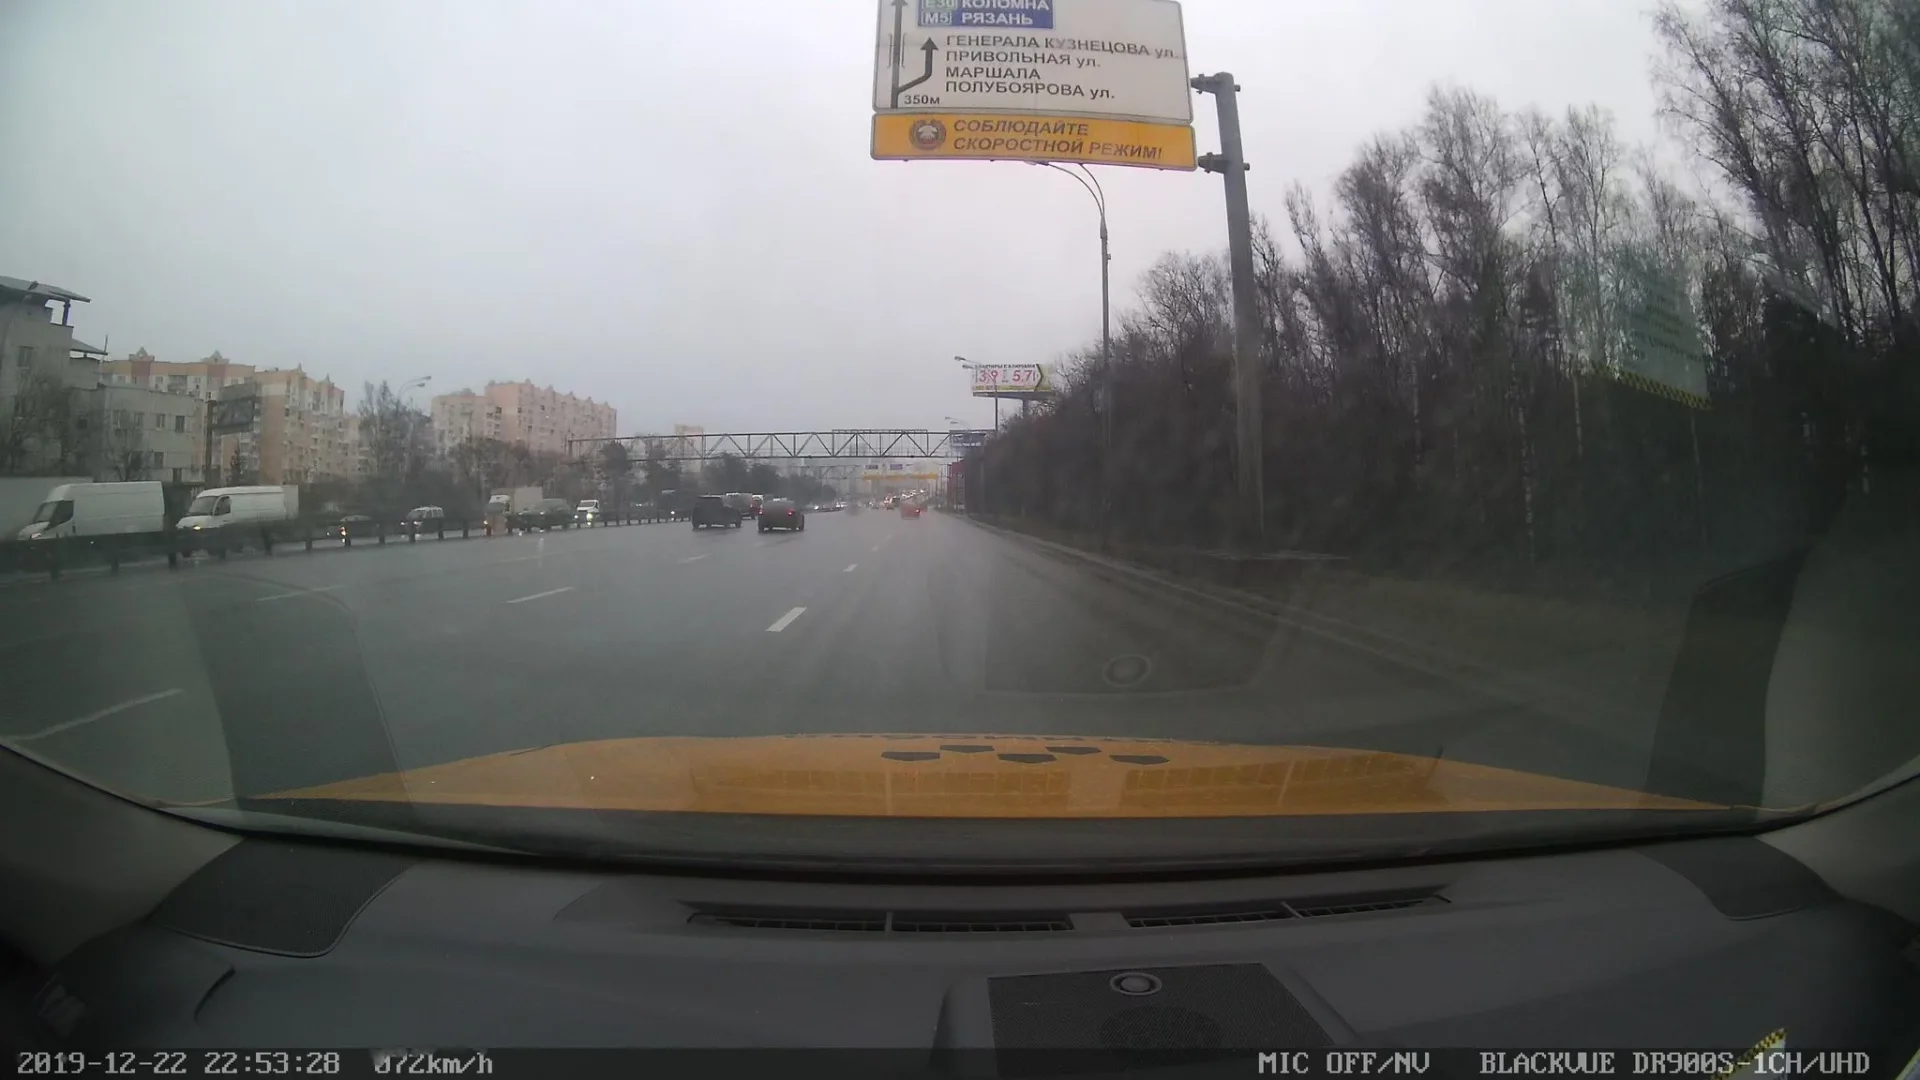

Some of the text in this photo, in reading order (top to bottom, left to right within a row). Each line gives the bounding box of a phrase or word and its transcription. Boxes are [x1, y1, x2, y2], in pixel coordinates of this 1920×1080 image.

[961, 0, 1050, 10] КОЛОМНА
[961, 12, 1034, 25] РЯЗАНЬ
[946, 35, 1040, 48] ГЕНЕРАЛА
[1045, 37, 1150, 55] КУЗНЕЦОВА
[946, 51, 1101, 68] ПРИВОЛЬНАЯ ул.
[946, 66, 1041, 80] МАРШАЛА
[946, 81, 1115, 100] ПОЛУБОЯРОВА ул.
[954, 119, 1089, 137] СОБЛЮДАЙТЕ
[954, 137, 1163, 159] СКОРОСТНОЙ РЕЖИМ!
